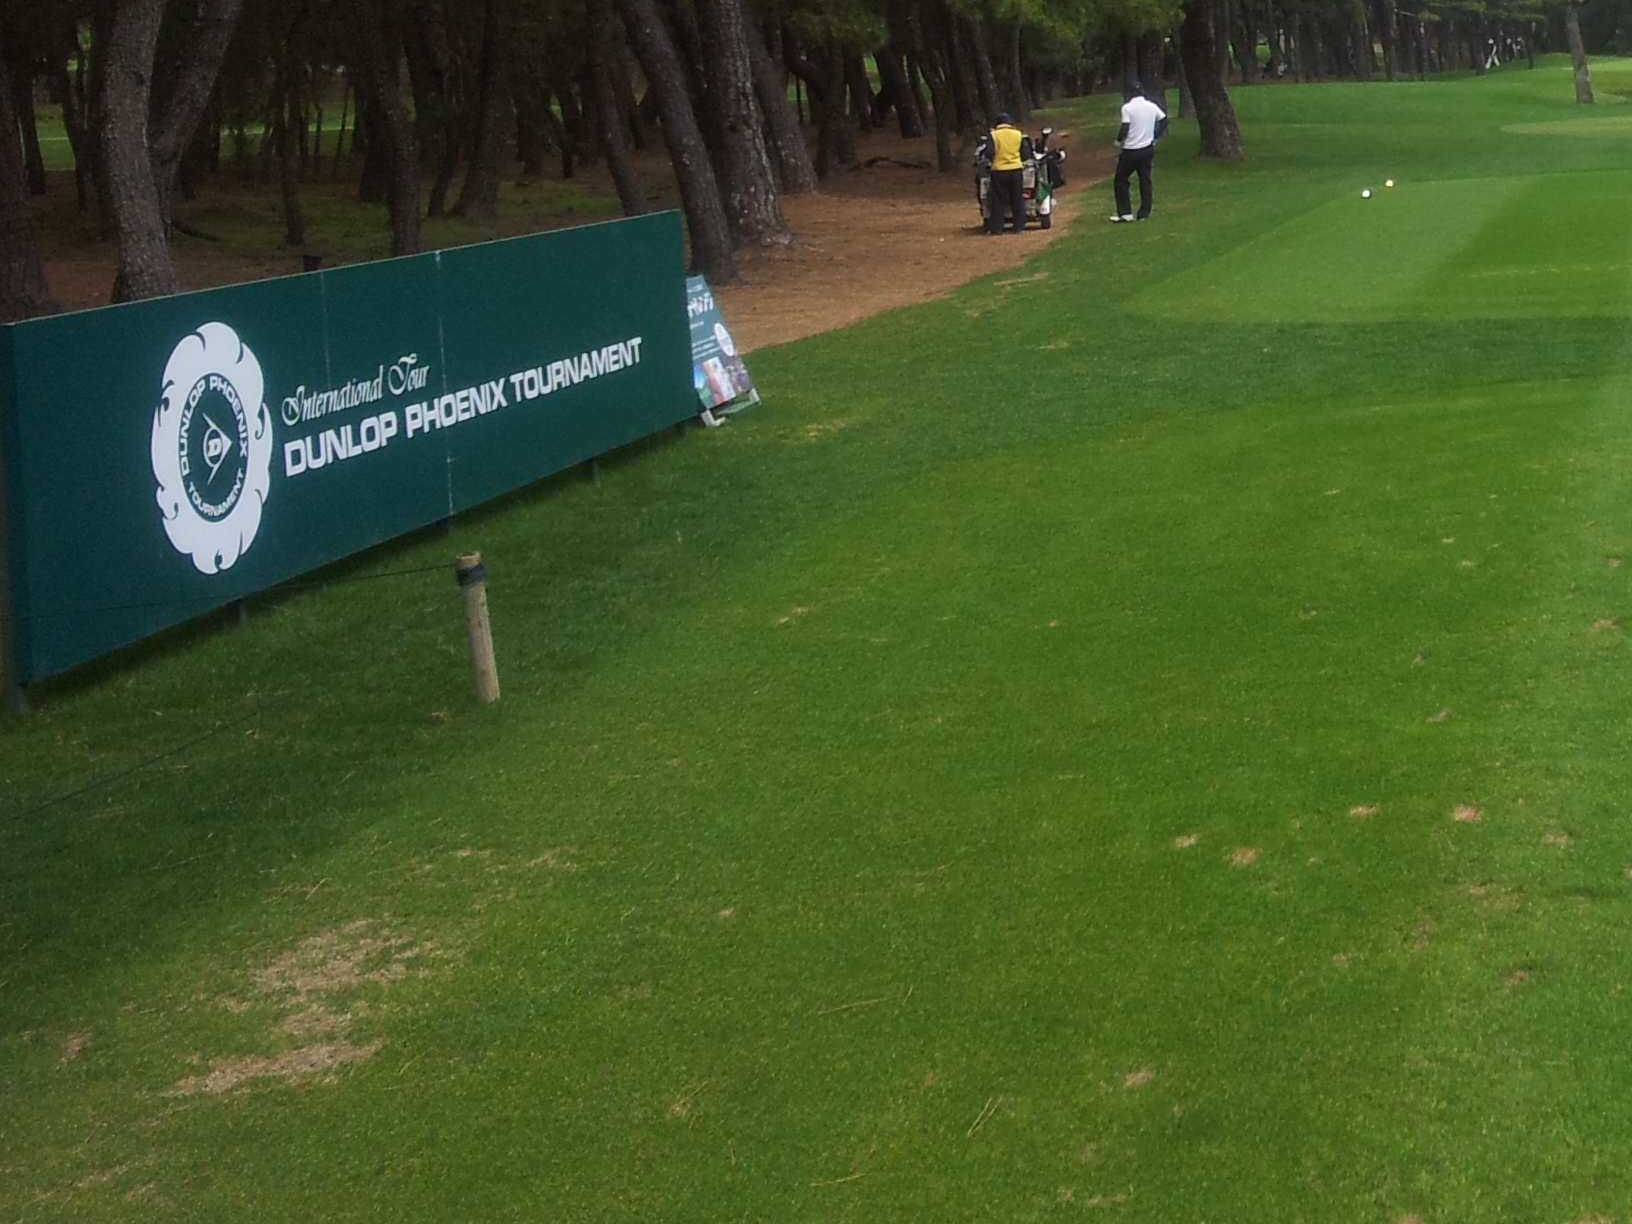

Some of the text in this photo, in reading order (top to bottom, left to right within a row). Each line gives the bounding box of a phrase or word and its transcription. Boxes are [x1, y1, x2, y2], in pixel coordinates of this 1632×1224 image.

[180, 375, 248, 477] DUNLOP PHOENIX
[281, 352, 430, 426] International Tour
[284, 411, 398, 477] DUNLOP
[404, 378, 508, 439] PHOENIX
[509, 336, 642, 403] TOURNAMENT
[188, 467, 244, 517] TOURNAMENT
